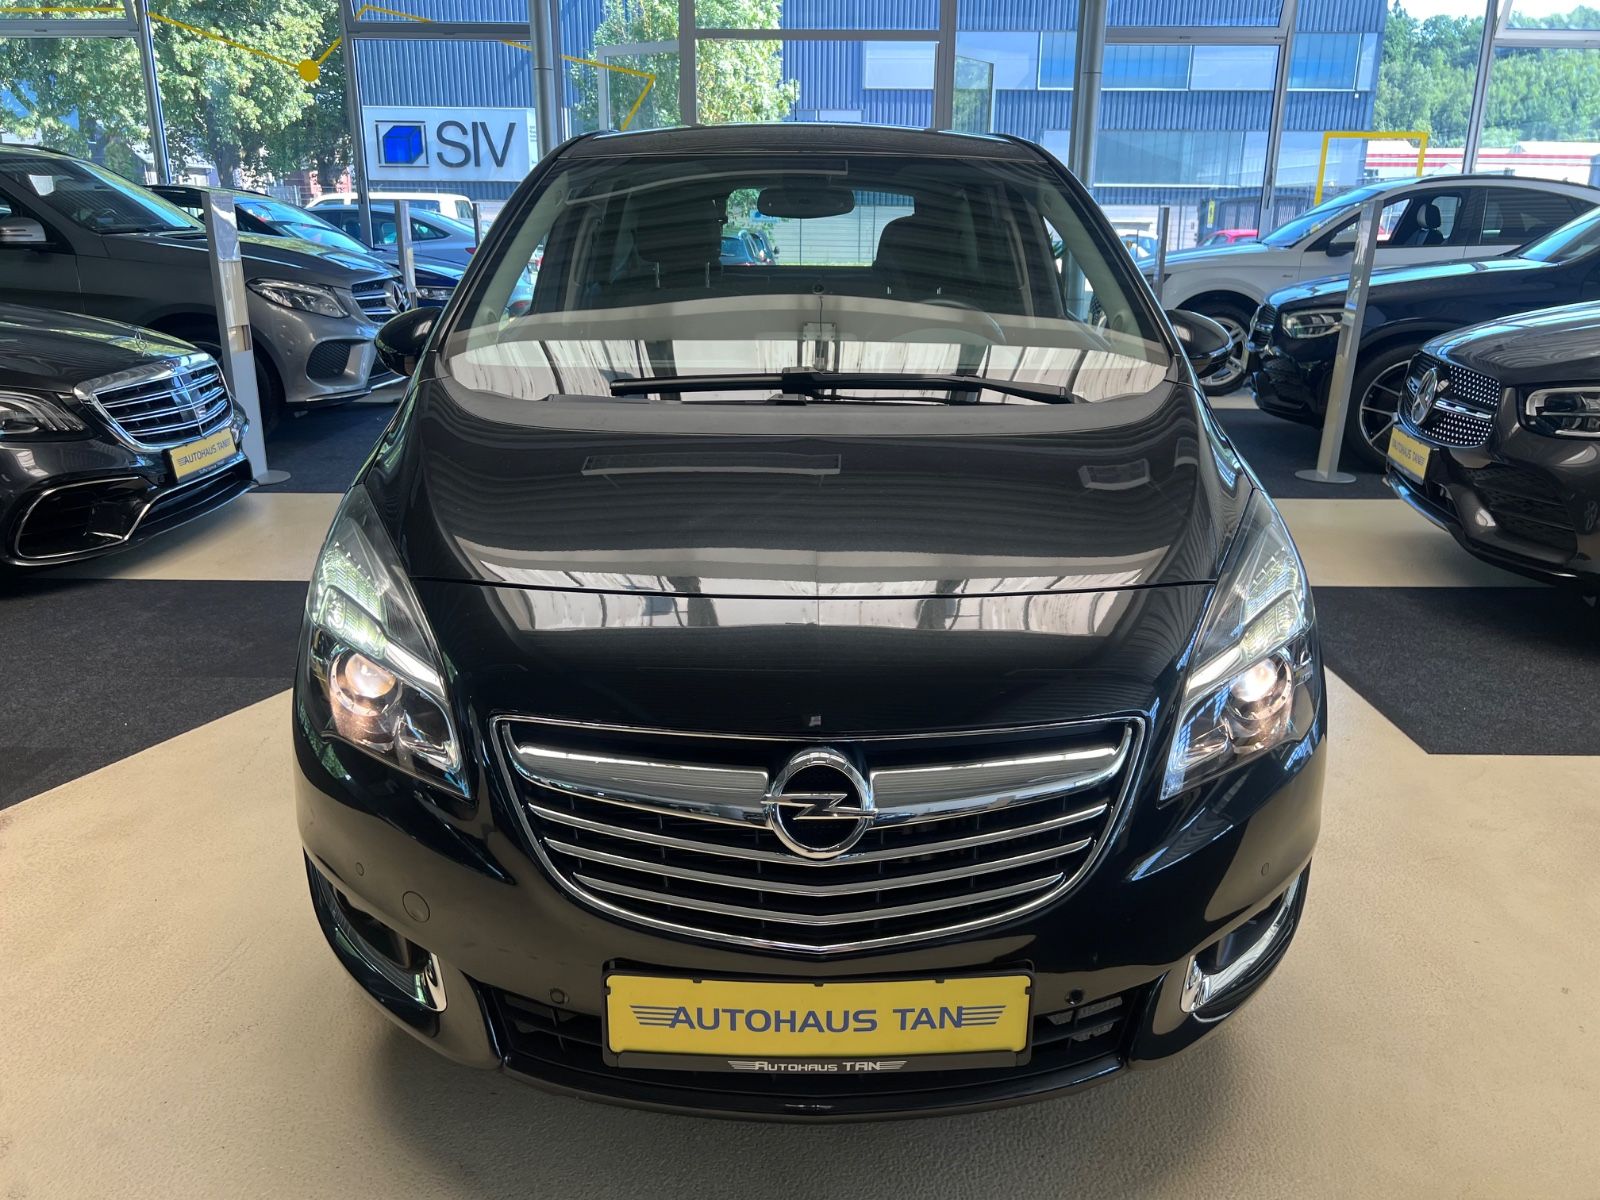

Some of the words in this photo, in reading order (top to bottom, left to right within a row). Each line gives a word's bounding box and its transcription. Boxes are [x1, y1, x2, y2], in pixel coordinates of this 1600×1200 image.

[436, 120, 517, 168] SIV
[184, 444, 217, 464] AUTOHAUS
[669, 1006, 878, 1033] AUTOHAUS
[892, 1006, 964, 1031] TAN
[842, 1061, 880, 1072] TAN
